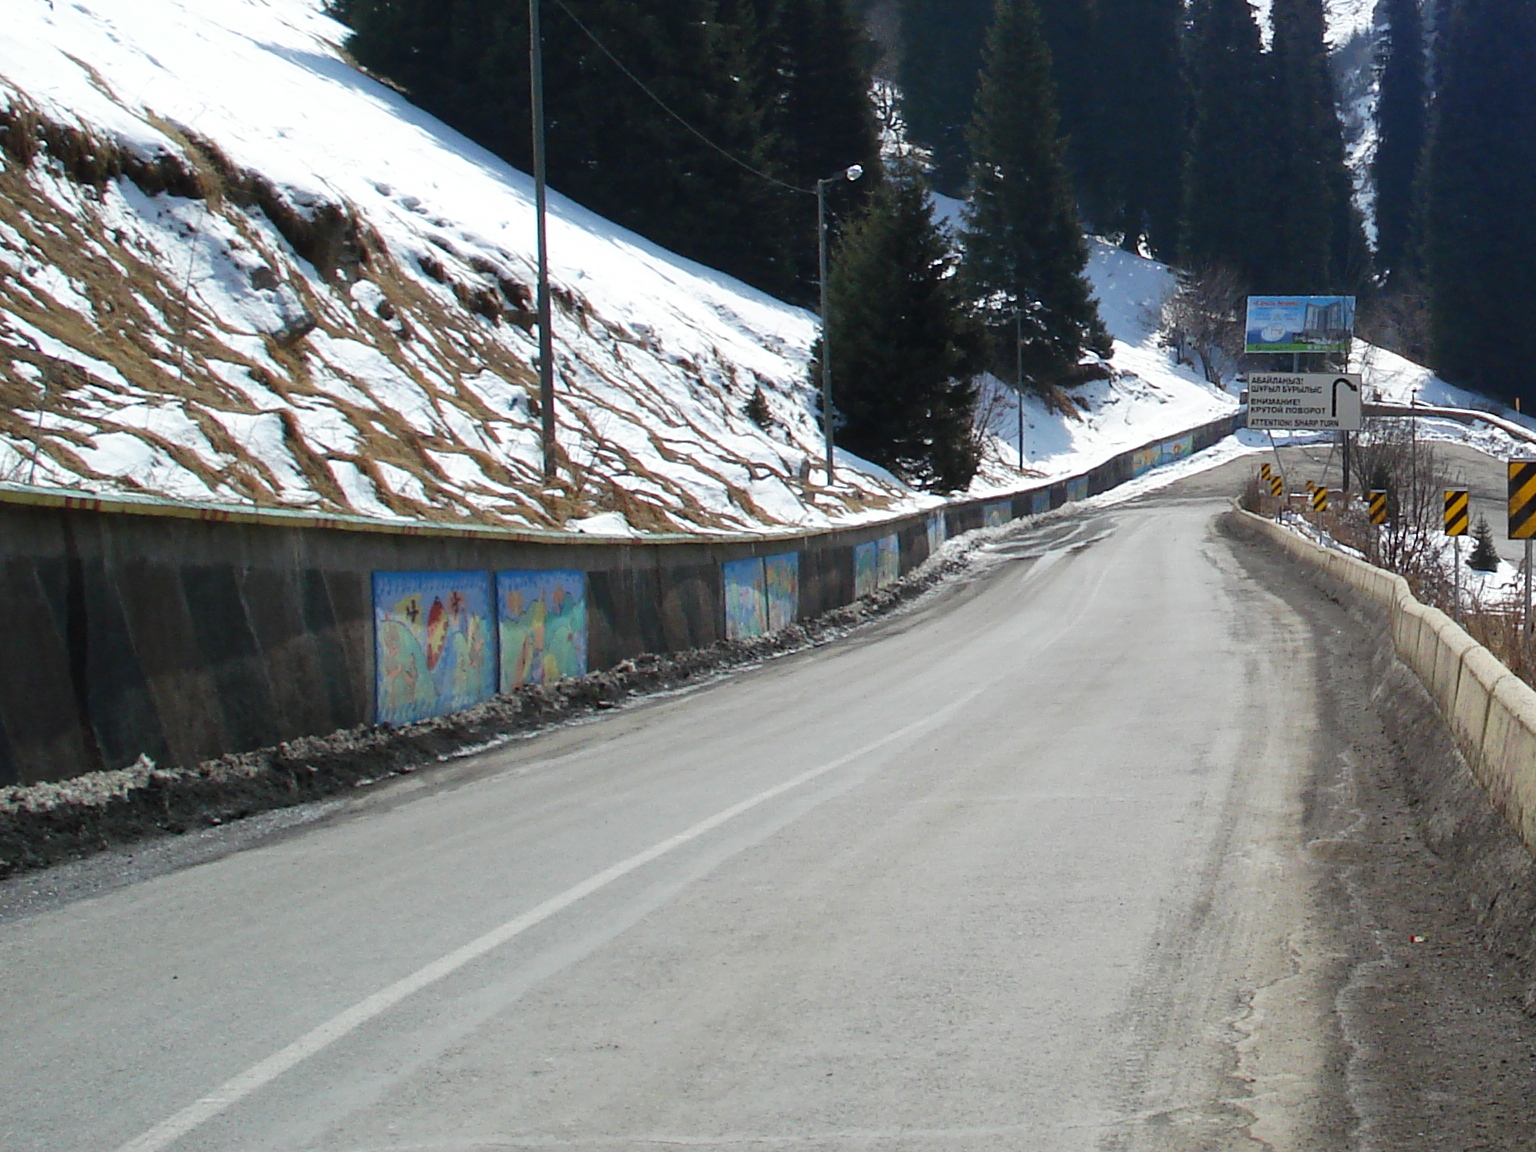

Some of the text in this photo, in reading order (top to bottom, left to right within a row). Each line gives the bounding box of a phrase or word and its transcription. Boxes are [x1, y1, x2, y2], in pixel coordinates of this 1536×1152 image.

[1250, 398, 1301, 406] ВНИМАНИЕ!
[1250, 405, 1326, 415] КРУТОЙ ПОВОРОТ
[1250, 418, 1339, 427] ATTENTION! SHARP TURN
